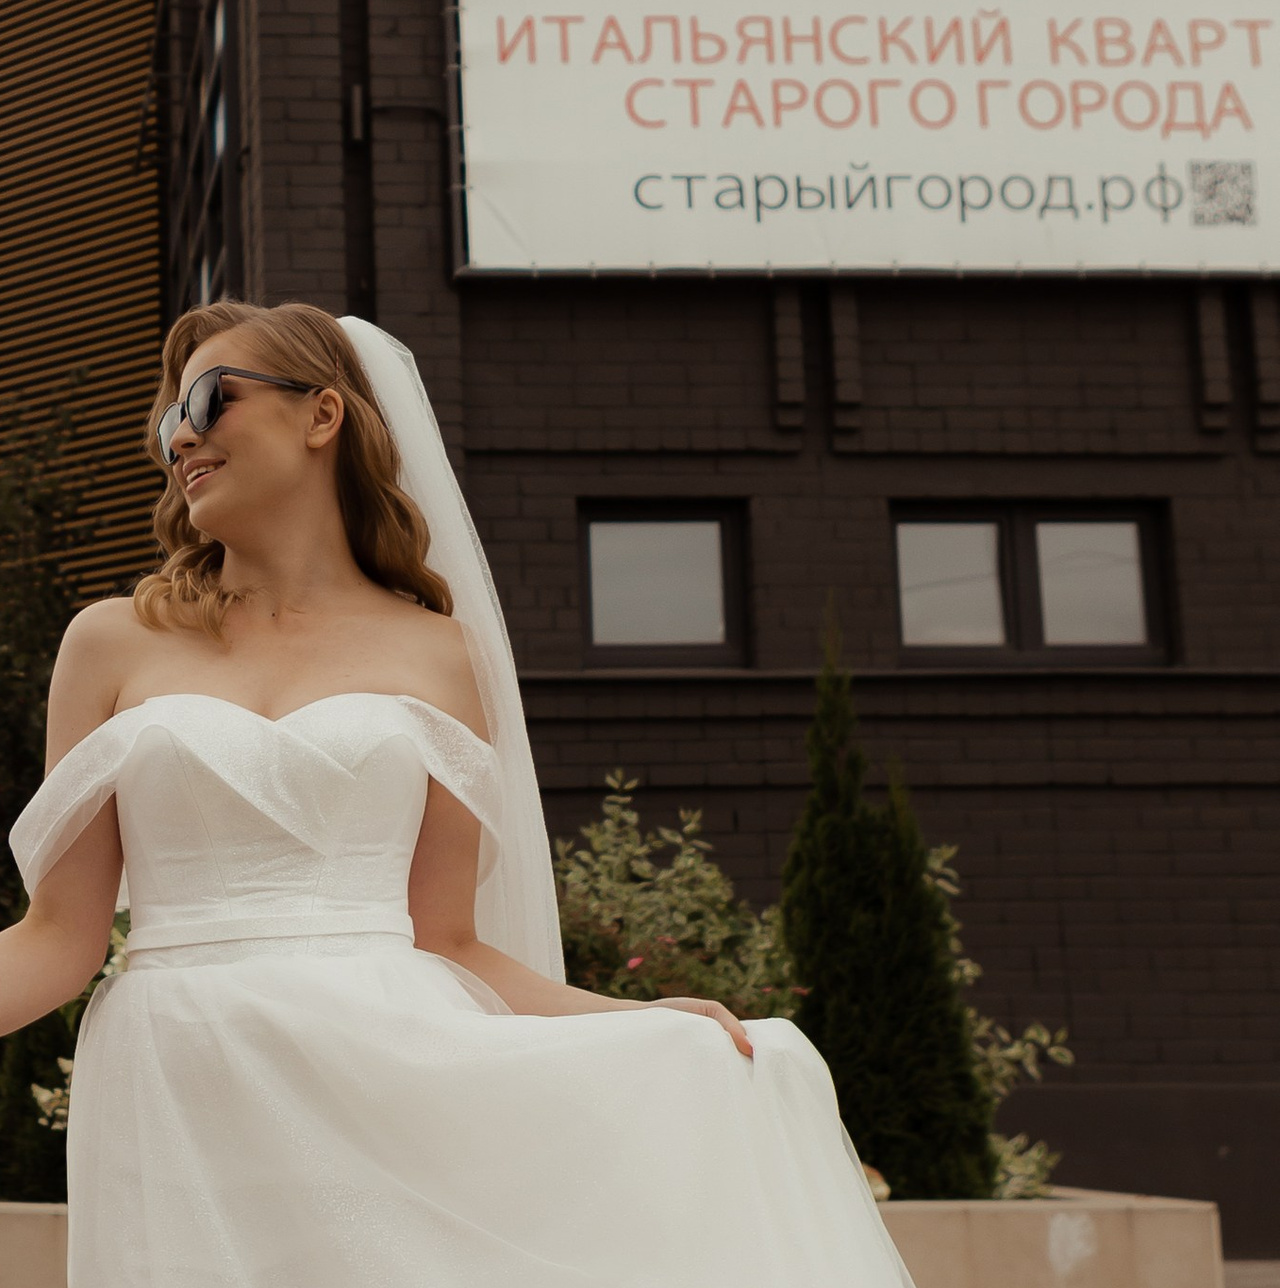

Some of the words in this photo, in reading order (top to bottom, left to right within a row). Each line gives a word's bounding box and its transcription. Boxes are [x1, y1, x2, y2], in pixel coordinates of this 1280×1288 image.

[496, 9, 1013, 66] ИТАЛЬЯНСКИЙ
[1046, 16, 1274, 68] КВАРТ
[623, 78, 957, 129] СТАРОГО
[976, 78, 1255, 140] ГОРОДА
[632, 159, 1185, 224] старыйгород.рф
